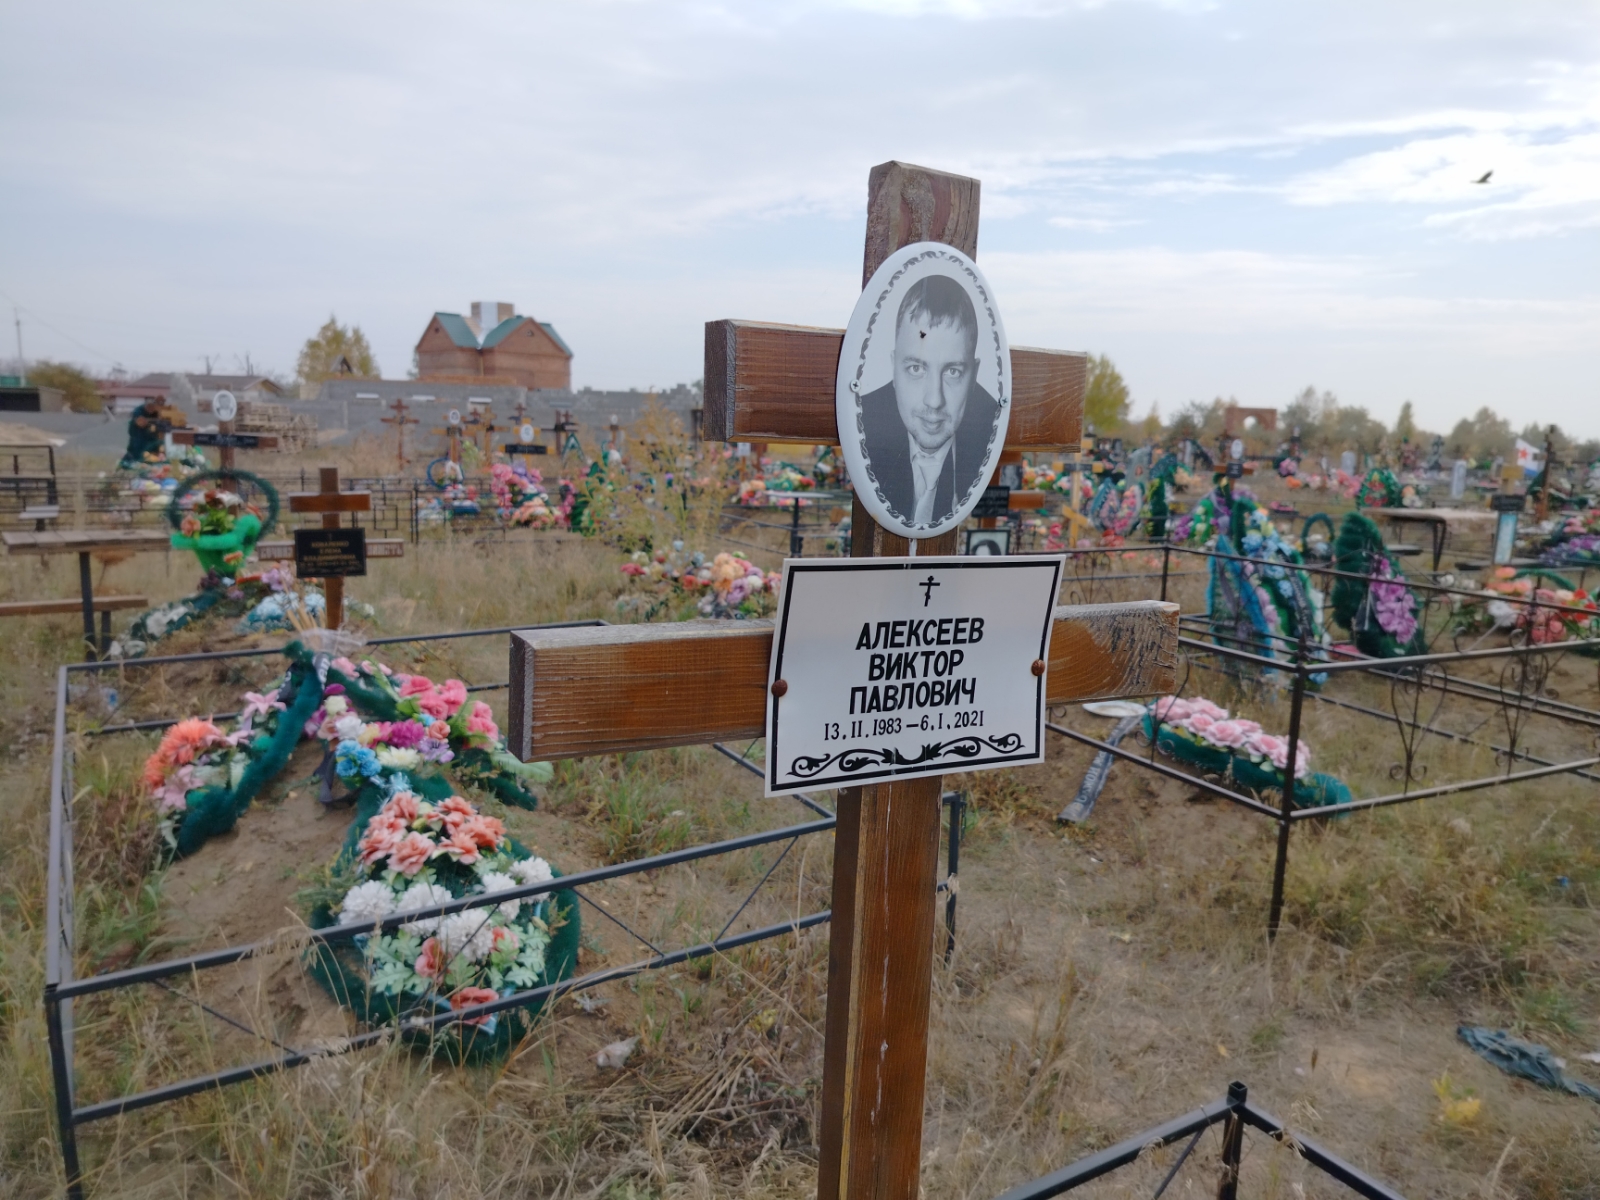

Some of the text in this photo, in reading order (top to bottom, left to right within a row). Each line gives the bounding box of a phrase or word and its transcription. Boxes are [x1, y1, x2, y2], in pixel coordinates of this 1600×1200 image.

[855, 617, 985, 651] АЛЕКСЕЕВ
[868, 649, 965, 682] ВИКТОР
[849, 677, 977, 715] ПАВЛОВИЧ
